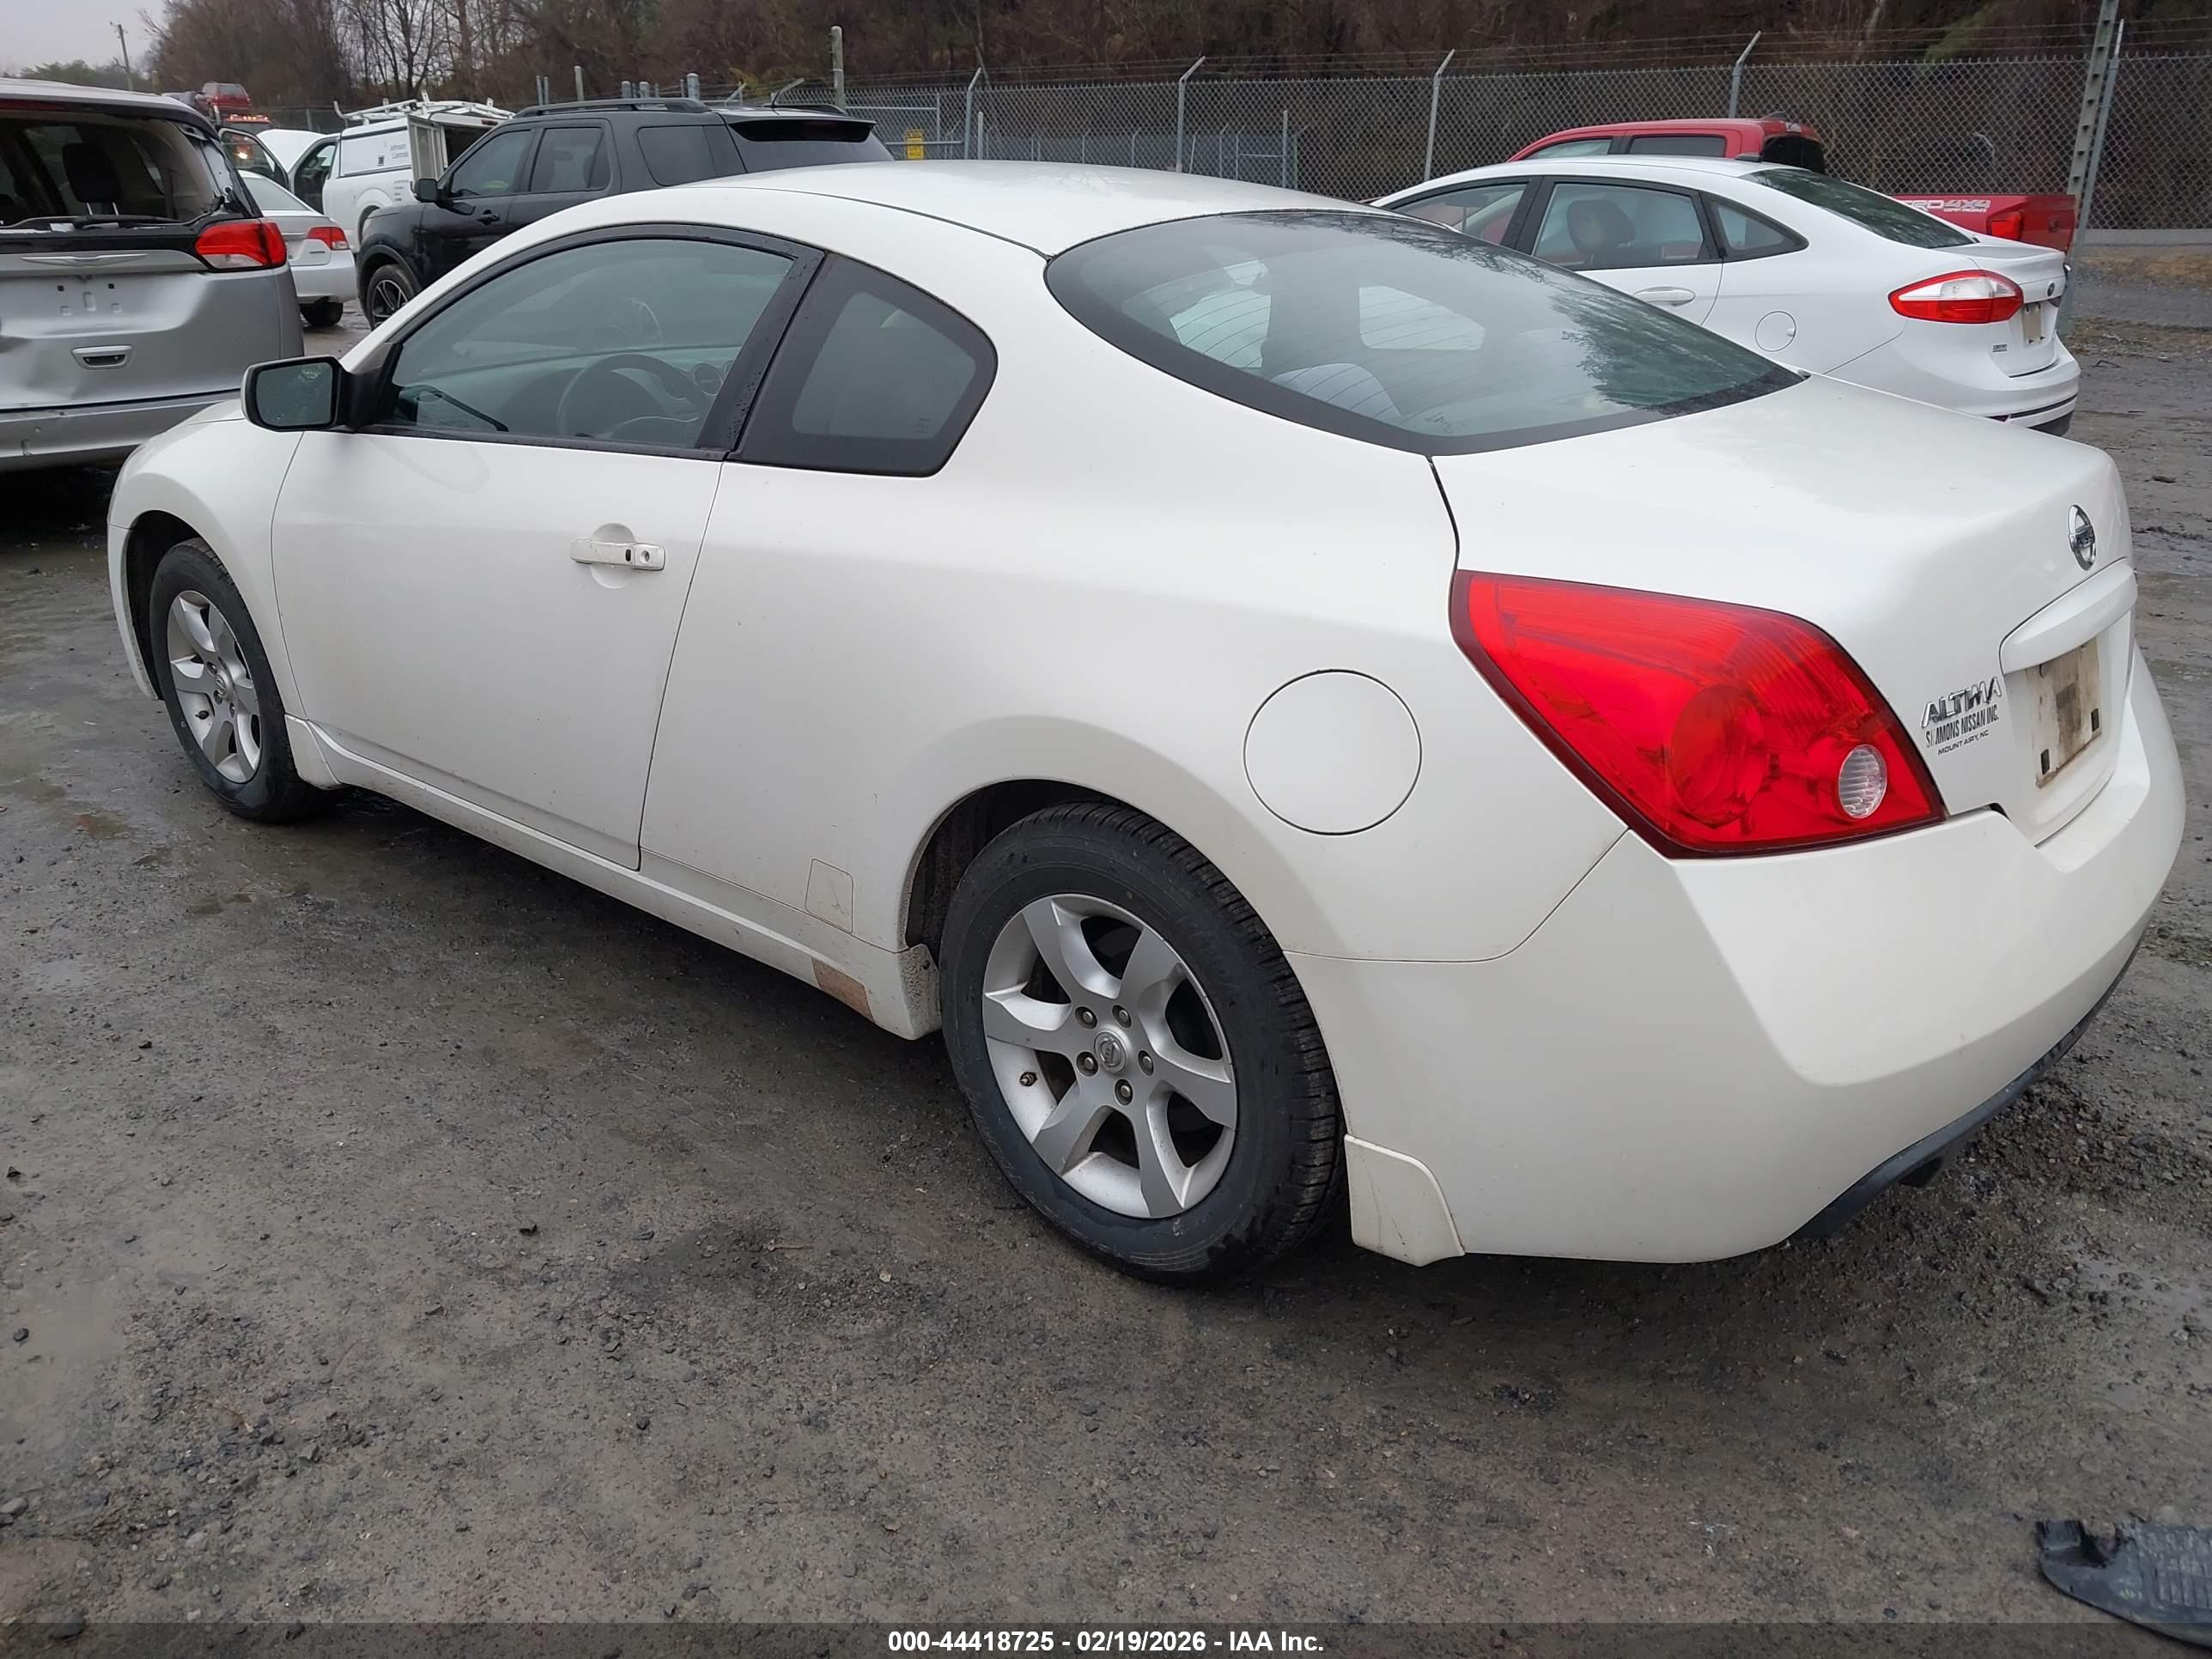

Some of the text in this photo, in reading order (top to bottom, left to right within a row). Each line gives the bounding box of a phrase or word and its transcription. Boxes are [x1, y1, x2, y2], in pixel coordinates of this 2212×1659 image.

[1961, 708, 1985, 735] NISSAN
[1937, 740, 1963, 756] MOUNT
[1979, 729, 1989, 738] NC
